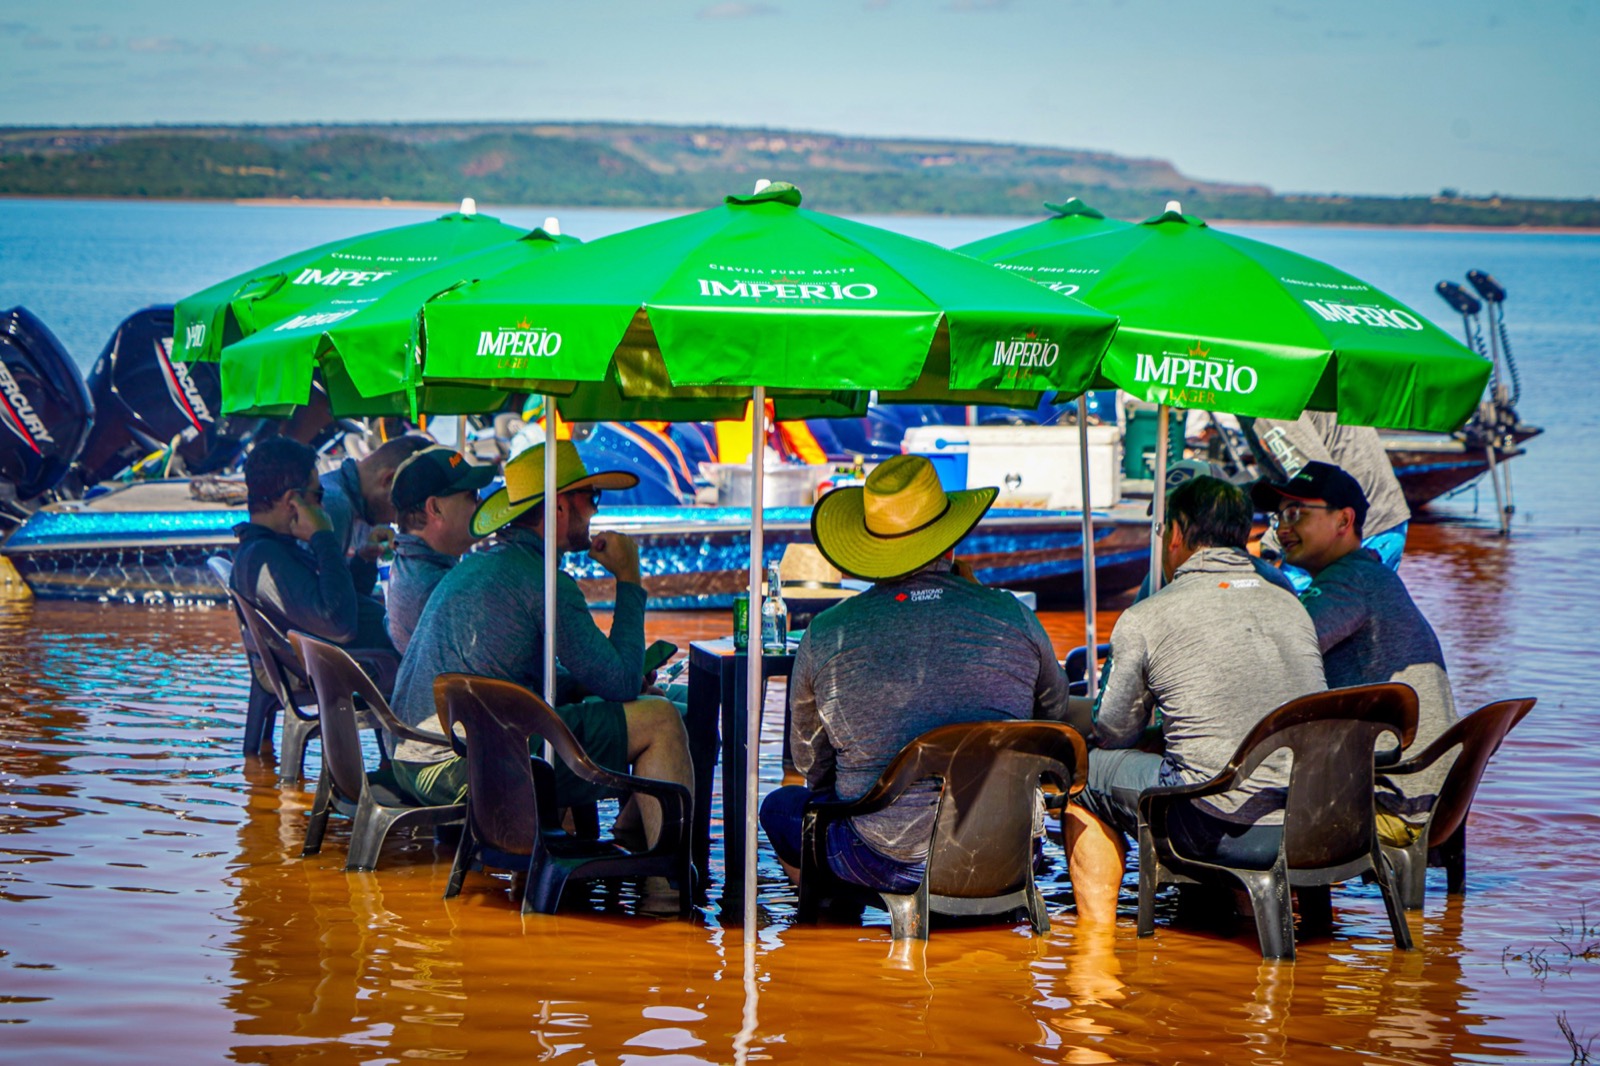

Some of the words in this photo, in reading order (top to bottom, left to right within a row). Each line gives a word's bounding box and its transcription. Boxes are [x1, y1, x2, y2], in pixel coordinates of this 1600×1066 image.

[697, 278, 878, 300] IMPERIO
[1303, 299, 1424, 331] IMPERIO
[476, 331, 563, 357] IMPERIO
[992, 340, 1059, 367] IMPERIO
[1134, 353, 1258, 394] IMPERIO
[0, 359, 54, 443] ERCURY
[1168, 387, 1217, 405] LAGER
